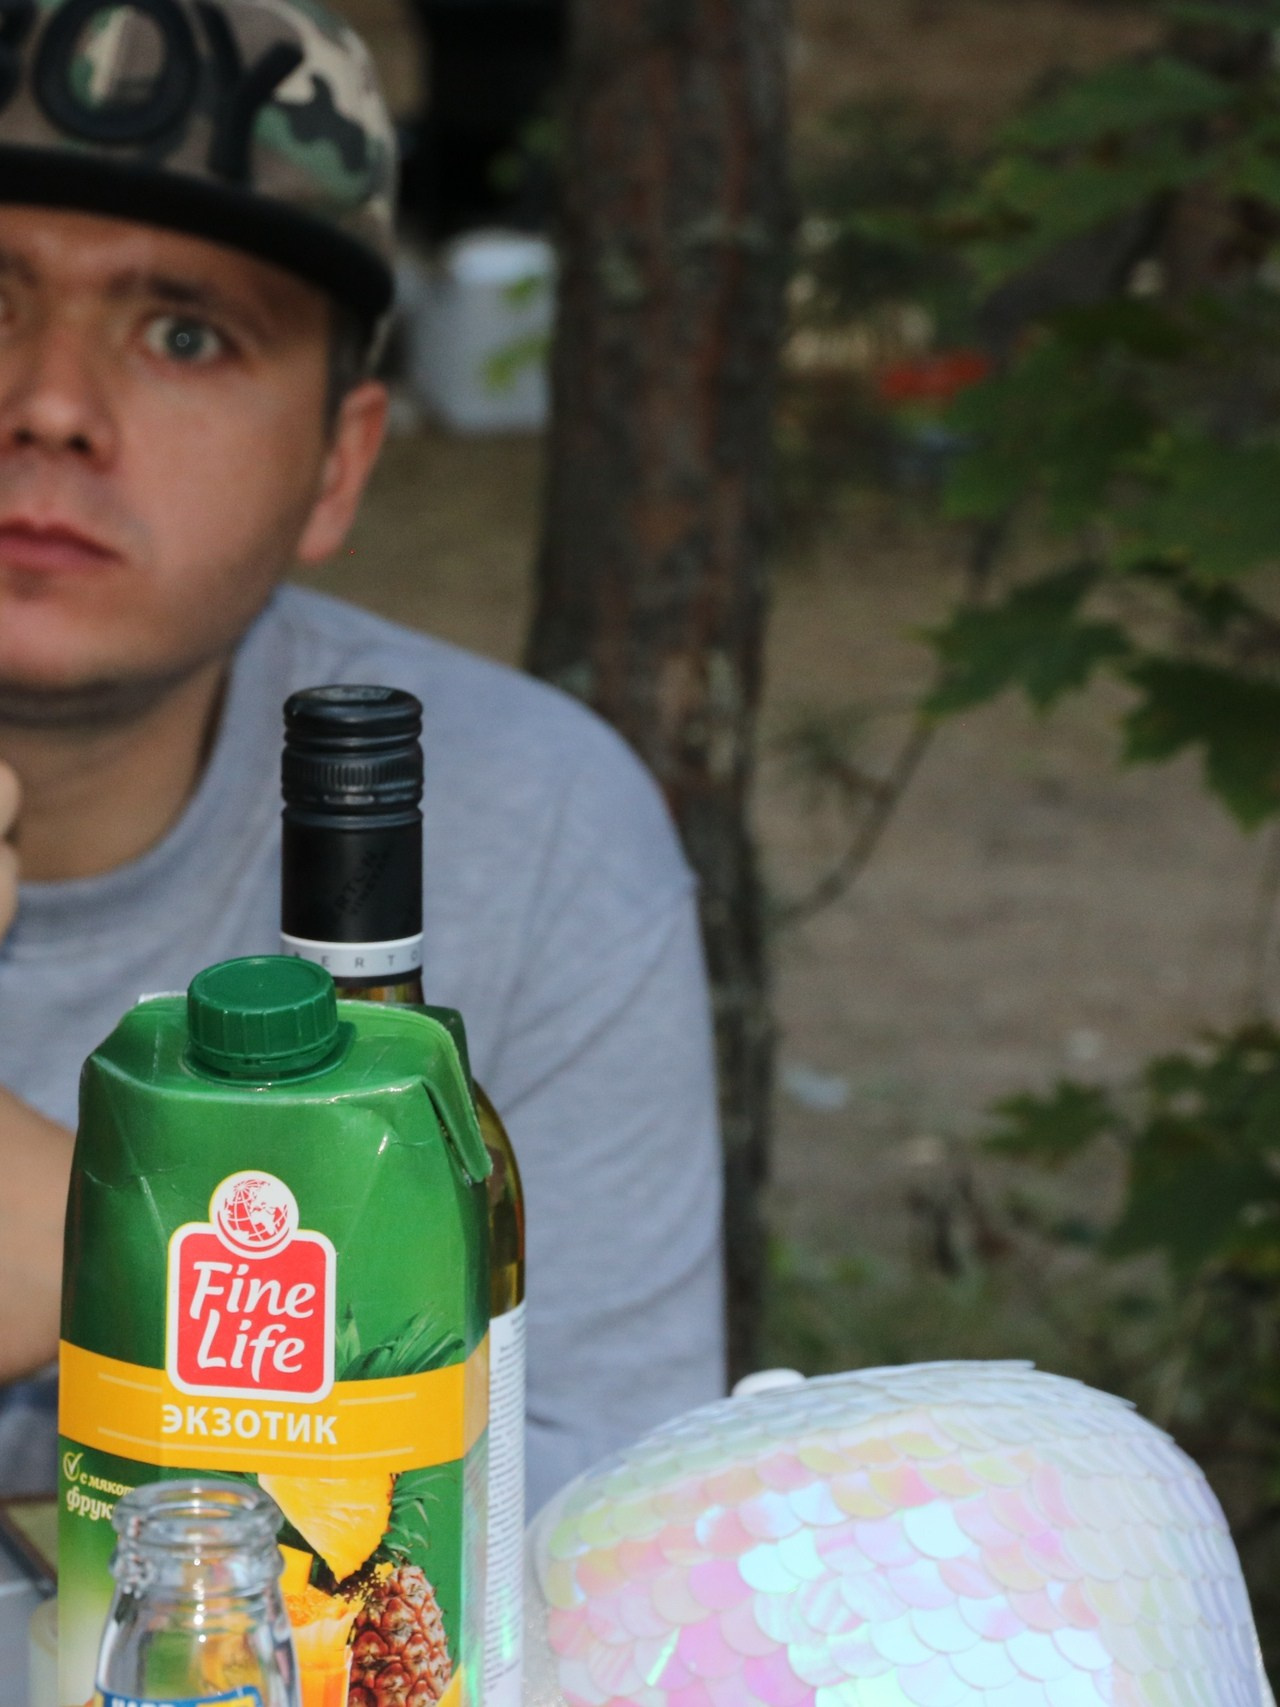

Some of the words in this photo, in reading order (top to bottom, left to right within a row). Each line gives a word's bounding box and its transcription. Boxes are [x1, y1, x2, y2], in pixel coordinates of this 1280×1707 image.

[189, 1261, 317, 1320] Fine
[197, 1309, 306, 1383] Life
[161, 1404, 338, 1446] ЭКЗОТИК
